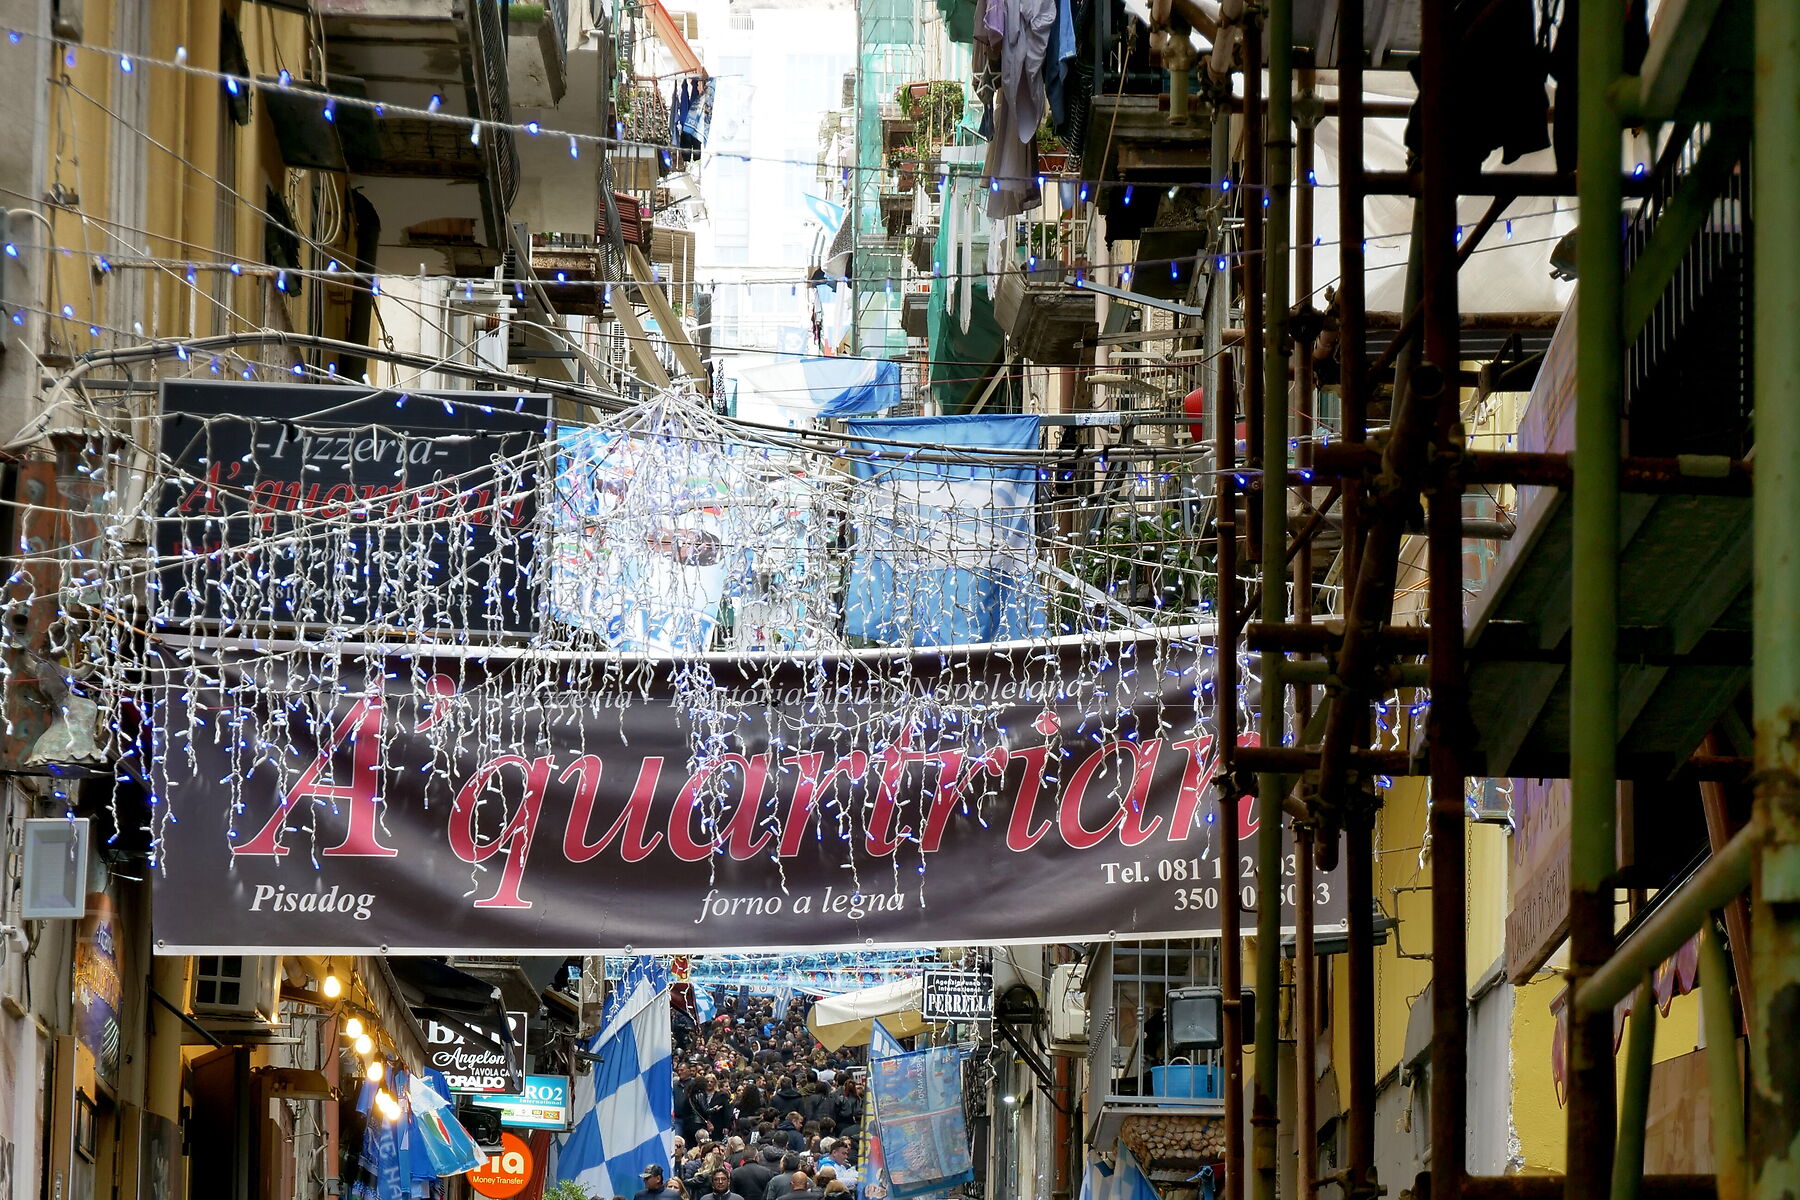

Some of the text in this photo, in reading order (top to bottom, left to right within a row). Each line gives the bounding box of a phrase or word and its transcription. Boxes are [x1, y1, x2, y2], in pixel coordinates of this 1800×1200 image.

[1101, 862, 1150, 885] Tel.
[1158, 859, 1201, 882] 081
[248, 884, 376, 921] Pisadog
[694, 886, 905, 924] forno a legna
[928, 993, 992, 1013] PERRELLA
[471, 1067, 523, 1078] TAVOLA CAA
[473, 1175, 524, 1186] Money Transfer
